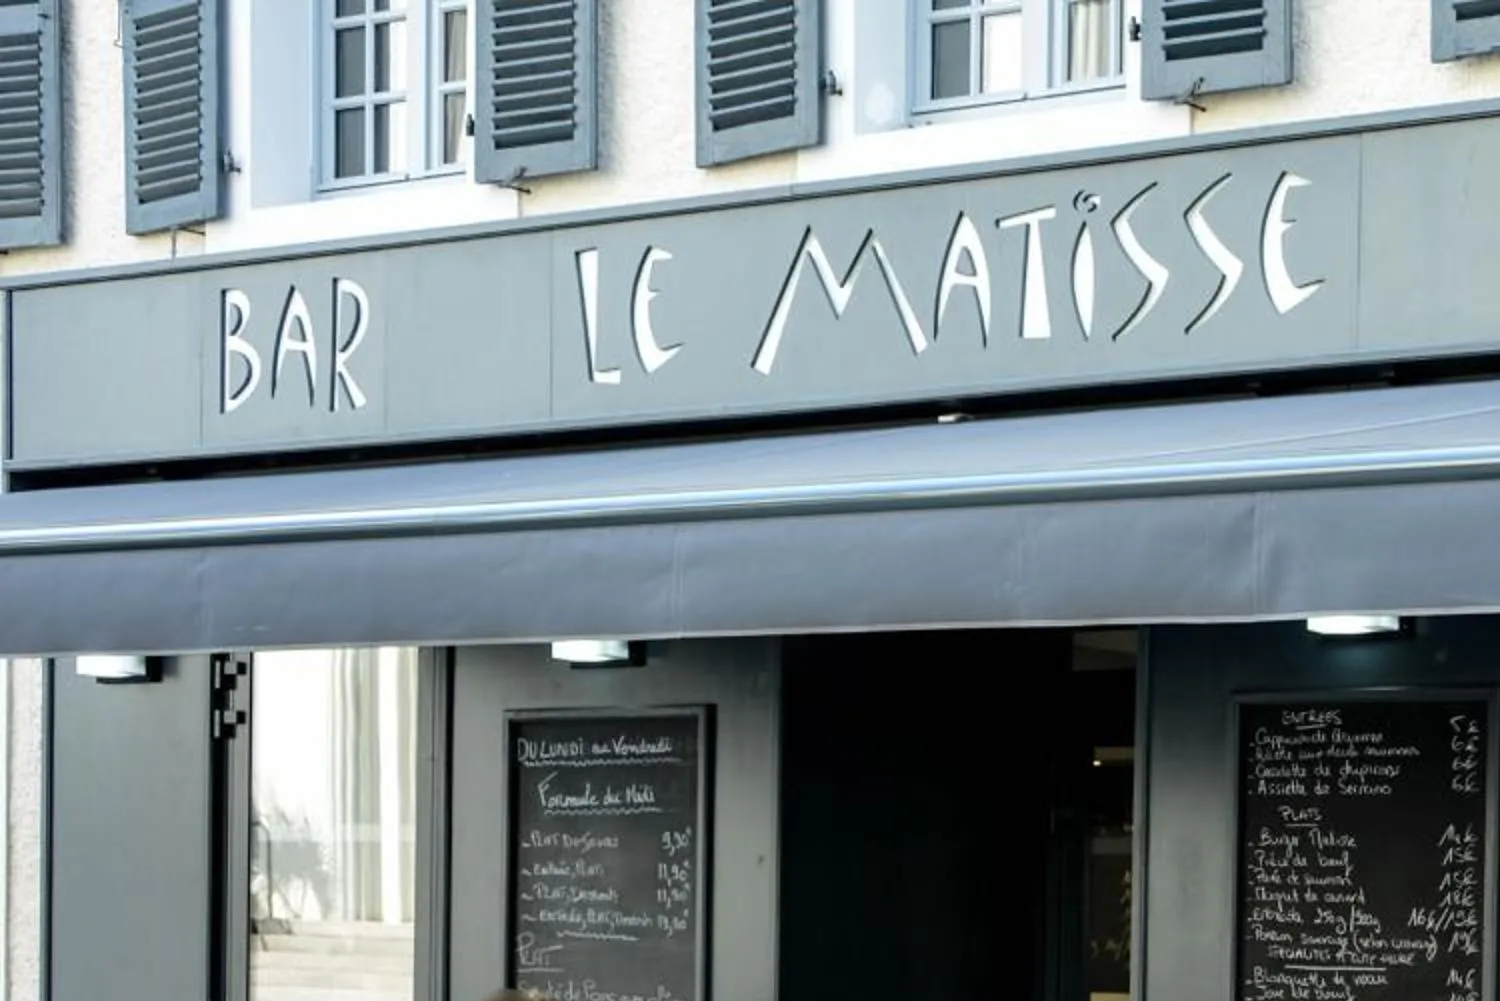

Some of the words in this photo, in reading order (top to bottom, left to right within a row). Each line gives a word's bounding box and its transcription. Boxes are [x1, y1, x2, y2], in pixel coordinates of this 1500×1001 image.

[219, 276, 370, 414] BAR
[574, 245, 684, 385] LE
[750, 170, 1326, 375] MATISSE
